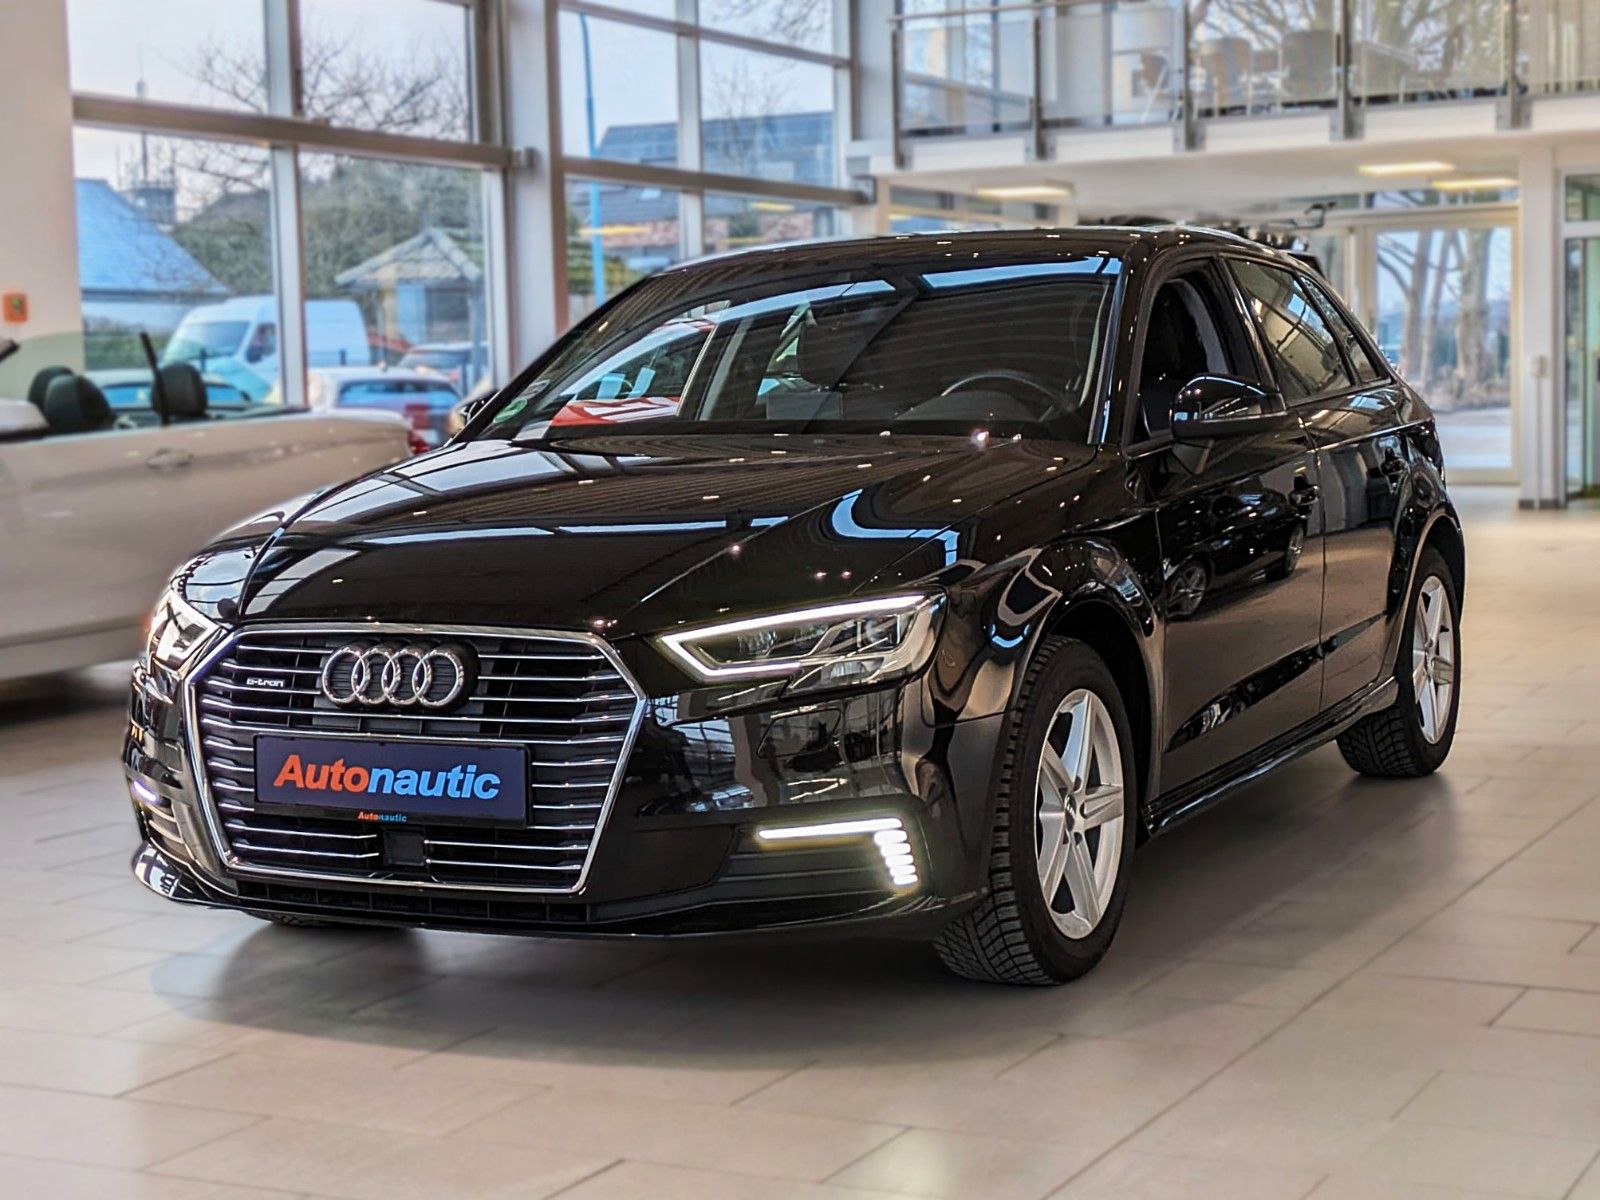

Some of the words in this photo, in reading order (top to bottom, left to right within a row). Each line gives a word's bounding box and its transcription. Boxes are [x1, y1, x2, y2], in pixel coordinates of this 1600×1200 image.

[246, 677, 284, 688] e-tron
[273, 754, 501, 800] Autonautic
[358, 811, 407, 822] Autonautic
